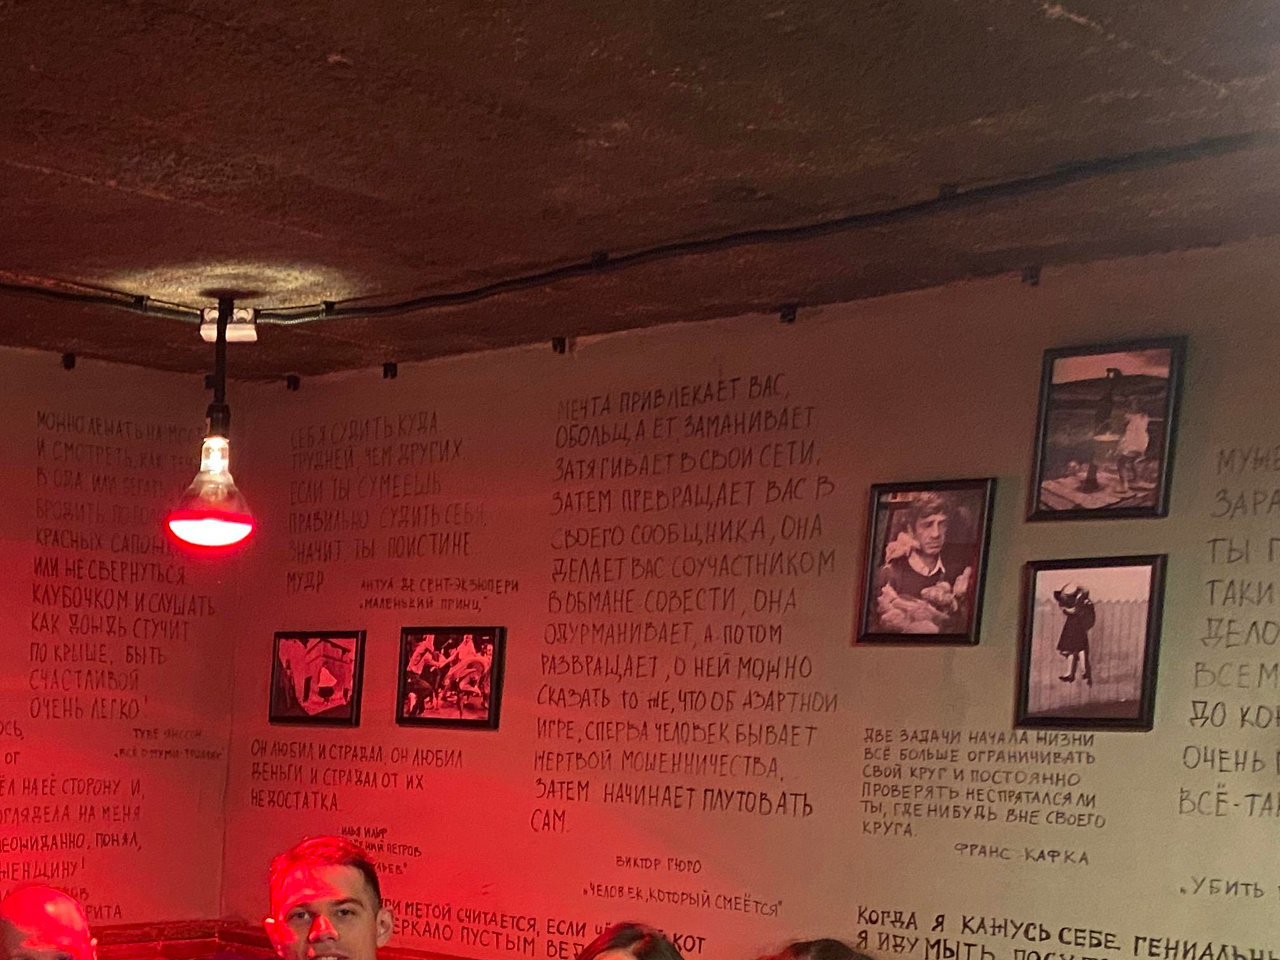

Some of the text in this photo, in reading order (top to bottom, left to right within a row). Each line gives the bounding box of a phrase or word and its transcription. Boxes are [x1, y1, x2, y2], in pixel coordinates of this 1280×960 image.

[620, 378, 740, 413] ПРИВЛЕКАЕТ
[685, 406, 815, 438] ЗАМАНИВАЕТ
[553, 453, 673, 481] ЗАТЯГИВАЕТ
[551, 478, 807, 515] ЗАТЕМ ПРЕВРАЩАЕТ ВАС
[781, 514, 822, 536] ОНА
[1206, 538, 1249, 564] ТЫ
[552, 550, 835, 583] ДЕЛАЕТ ВАС СОУЧАСТНИКОМ
[32, 583, 129, 610] КЛУБОЧКОМ
[754, 589, 797, 613] ОНА
[31, 611, 188, 641] КАК СТУЧИТ
[724, 623, 782, 645] ПОТОМ
[29, 642, 167, 665] ПО БЫТЬ
[694, 653, 729, 678] НЕЙ
[29, 669, 138, 690] СЧАСТЛИВОЙ
[538, 684, 610, 708] СКАЗАТЬ
[30, 698, 84, 720] ОЧЕНЬ
[1189, 700, 1226, 728] ДО
[585, 720, 818, 746] СПЕРВА ЧЕЛОВЕК БЫВАЕТ
[863, 728, 1028, 744] ДВЕ ЗАДАЧИ НАЧАЛА
[251, 739, 314, 759] ОН ЛЮБИЛ
[864, 747, 1095, 764] ВСЁ БОЛЬШЕ ОГРАНИЧИВАТЬ
[1183, 746, 1265, 773] ОЧЕНЬ
[62, 778, 120, 795] СТОРОНУ
[382, 772, 423, 790] ОТ ИХ
[863, 764, 1081, 786] СВОЙ КРУГ И ПОСТОЯННО
[535, 778, 813, 818] ЗАТЕМ НАЧИНАЕТ ПЛУТОВАТЬ
[862, 782, 1096, 808] ПРОВЕРЯТЬ ЛИ
[79, 806, 95, 821] НА
[103, 806, 140, 822] МЕНЯ
[894, 803, 1106, 828] ГДЕ НИБУДЬ ВНЕ СВОЕГО
[387, 844, 421, 856] ПЕТРОВ
[955, 843, 1089, 865] ФРАНС КАФКА
[616, 856, 701, 874] ВИКТОР ГЮГО
[649, 889, 711, 908] КОТОРЫЙ
[547, 921, 586, 937] ЕСЛИ
[857, 906, 1120, 951] КОГДА Я КАЖУСЬ СЕБЕ
[461, 929, 535, 958] ПУСТЫМ
[672, 934, 706, 954] КОТ
[857, 930, 868, 950] Я
[878, 933, 919, 952] ИДУ
